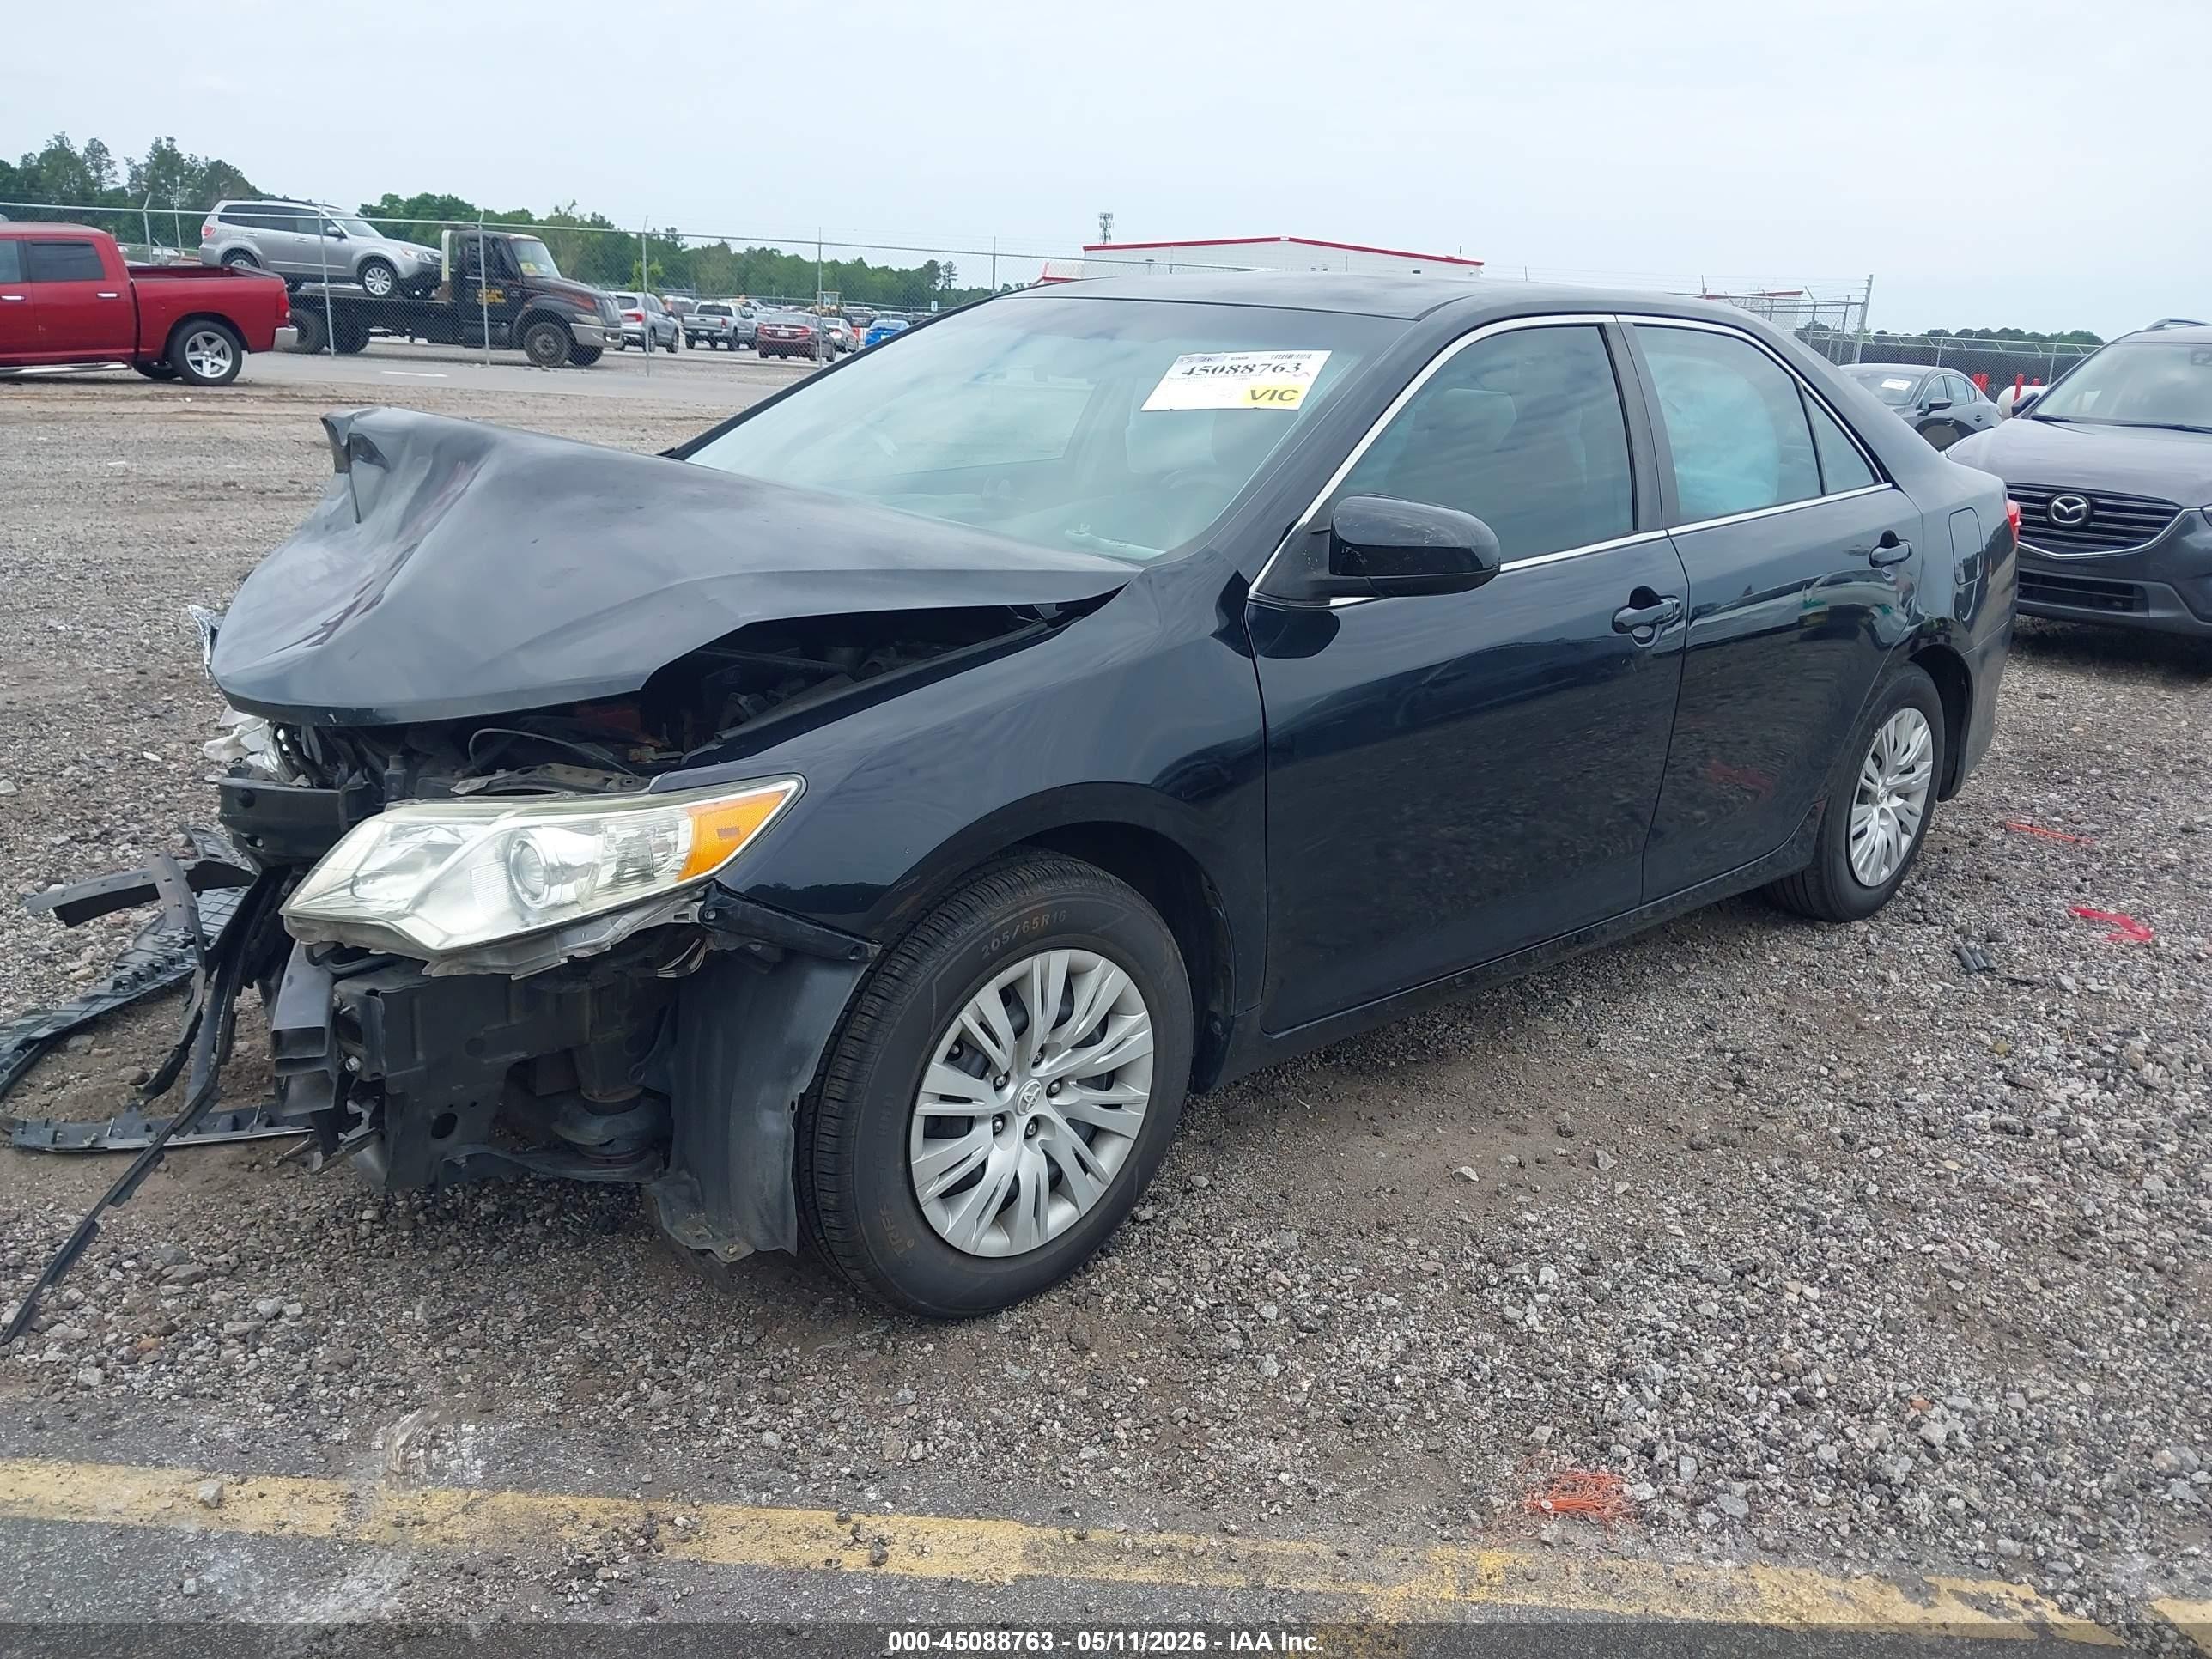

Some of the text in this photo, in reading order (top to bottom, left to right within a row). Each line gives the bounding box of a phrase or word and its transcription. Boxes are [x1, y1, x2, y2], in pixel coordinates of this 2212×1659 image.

[1182, 362, 1301, 376] 45088763
[1250, 389, 1299, 401] VIC
[981, 910, 1066, 959] 205/65R16
